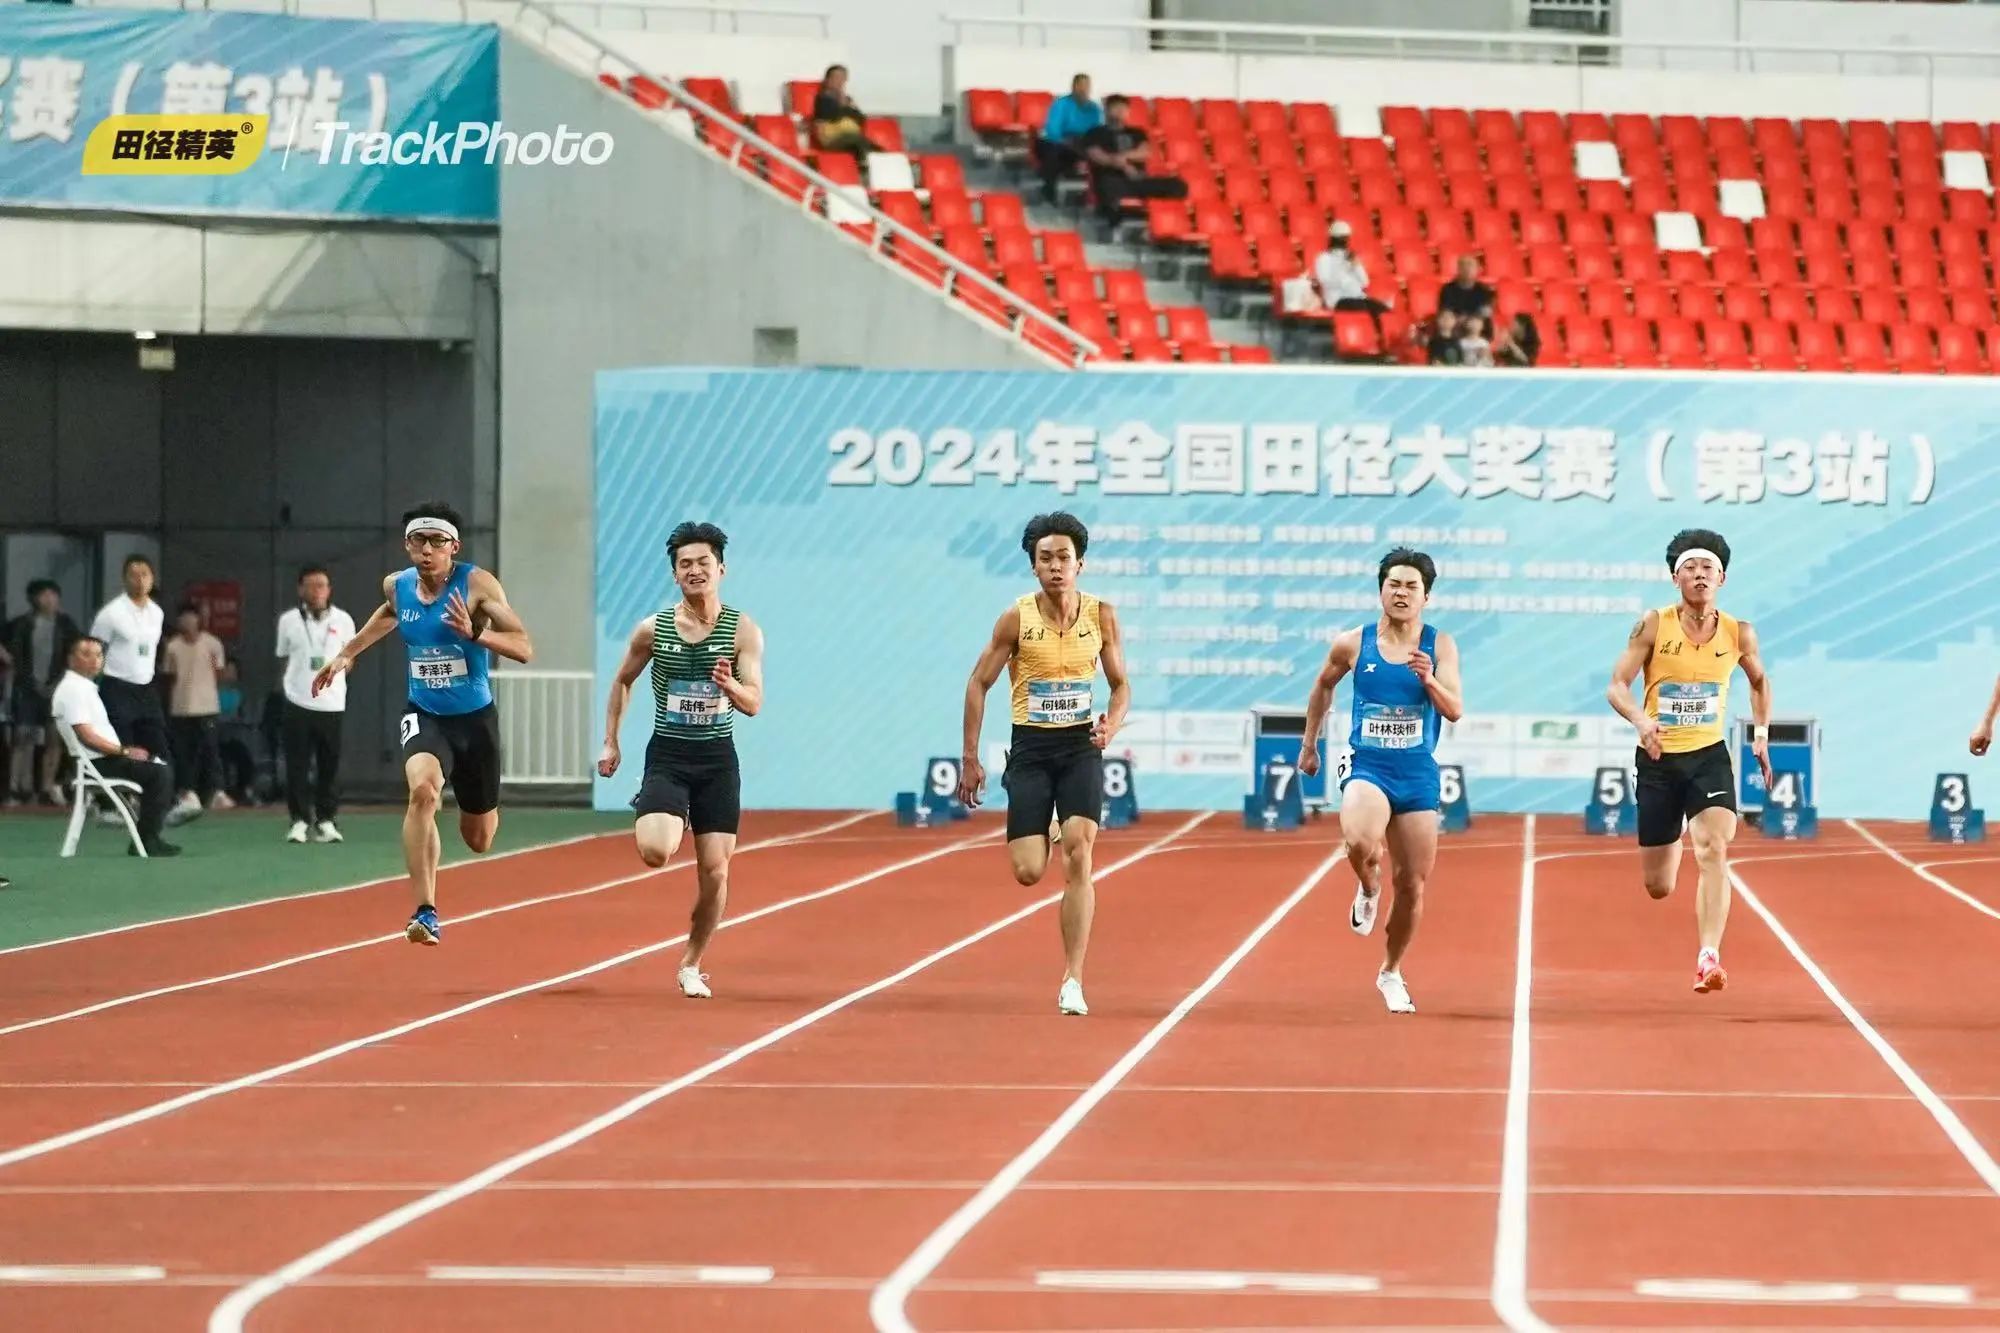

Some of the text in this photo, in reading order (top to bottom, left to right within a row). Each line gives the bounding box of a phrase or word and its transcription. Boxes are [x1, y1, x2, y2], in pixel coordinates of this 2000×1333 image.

[418, 663, 453, 677] 李泽洋
[424, 678, 452, 689] 1294
[680, 699, 717, 712] 陆伟一
[684, 714, 713, 725] 1385
[1676, 715, 1704, 725] 1097
[931, 762, 958, 796] 9
[1103, 763, 1127, 797] 8
[1270, 766, 1295, 801] 7
[1439, 768, 1462, 803] 6
[1600, 771, 1625, 806] 5
[1770, 772, 1797, 809] 4
[1940, 777, 1966, 813] 3
